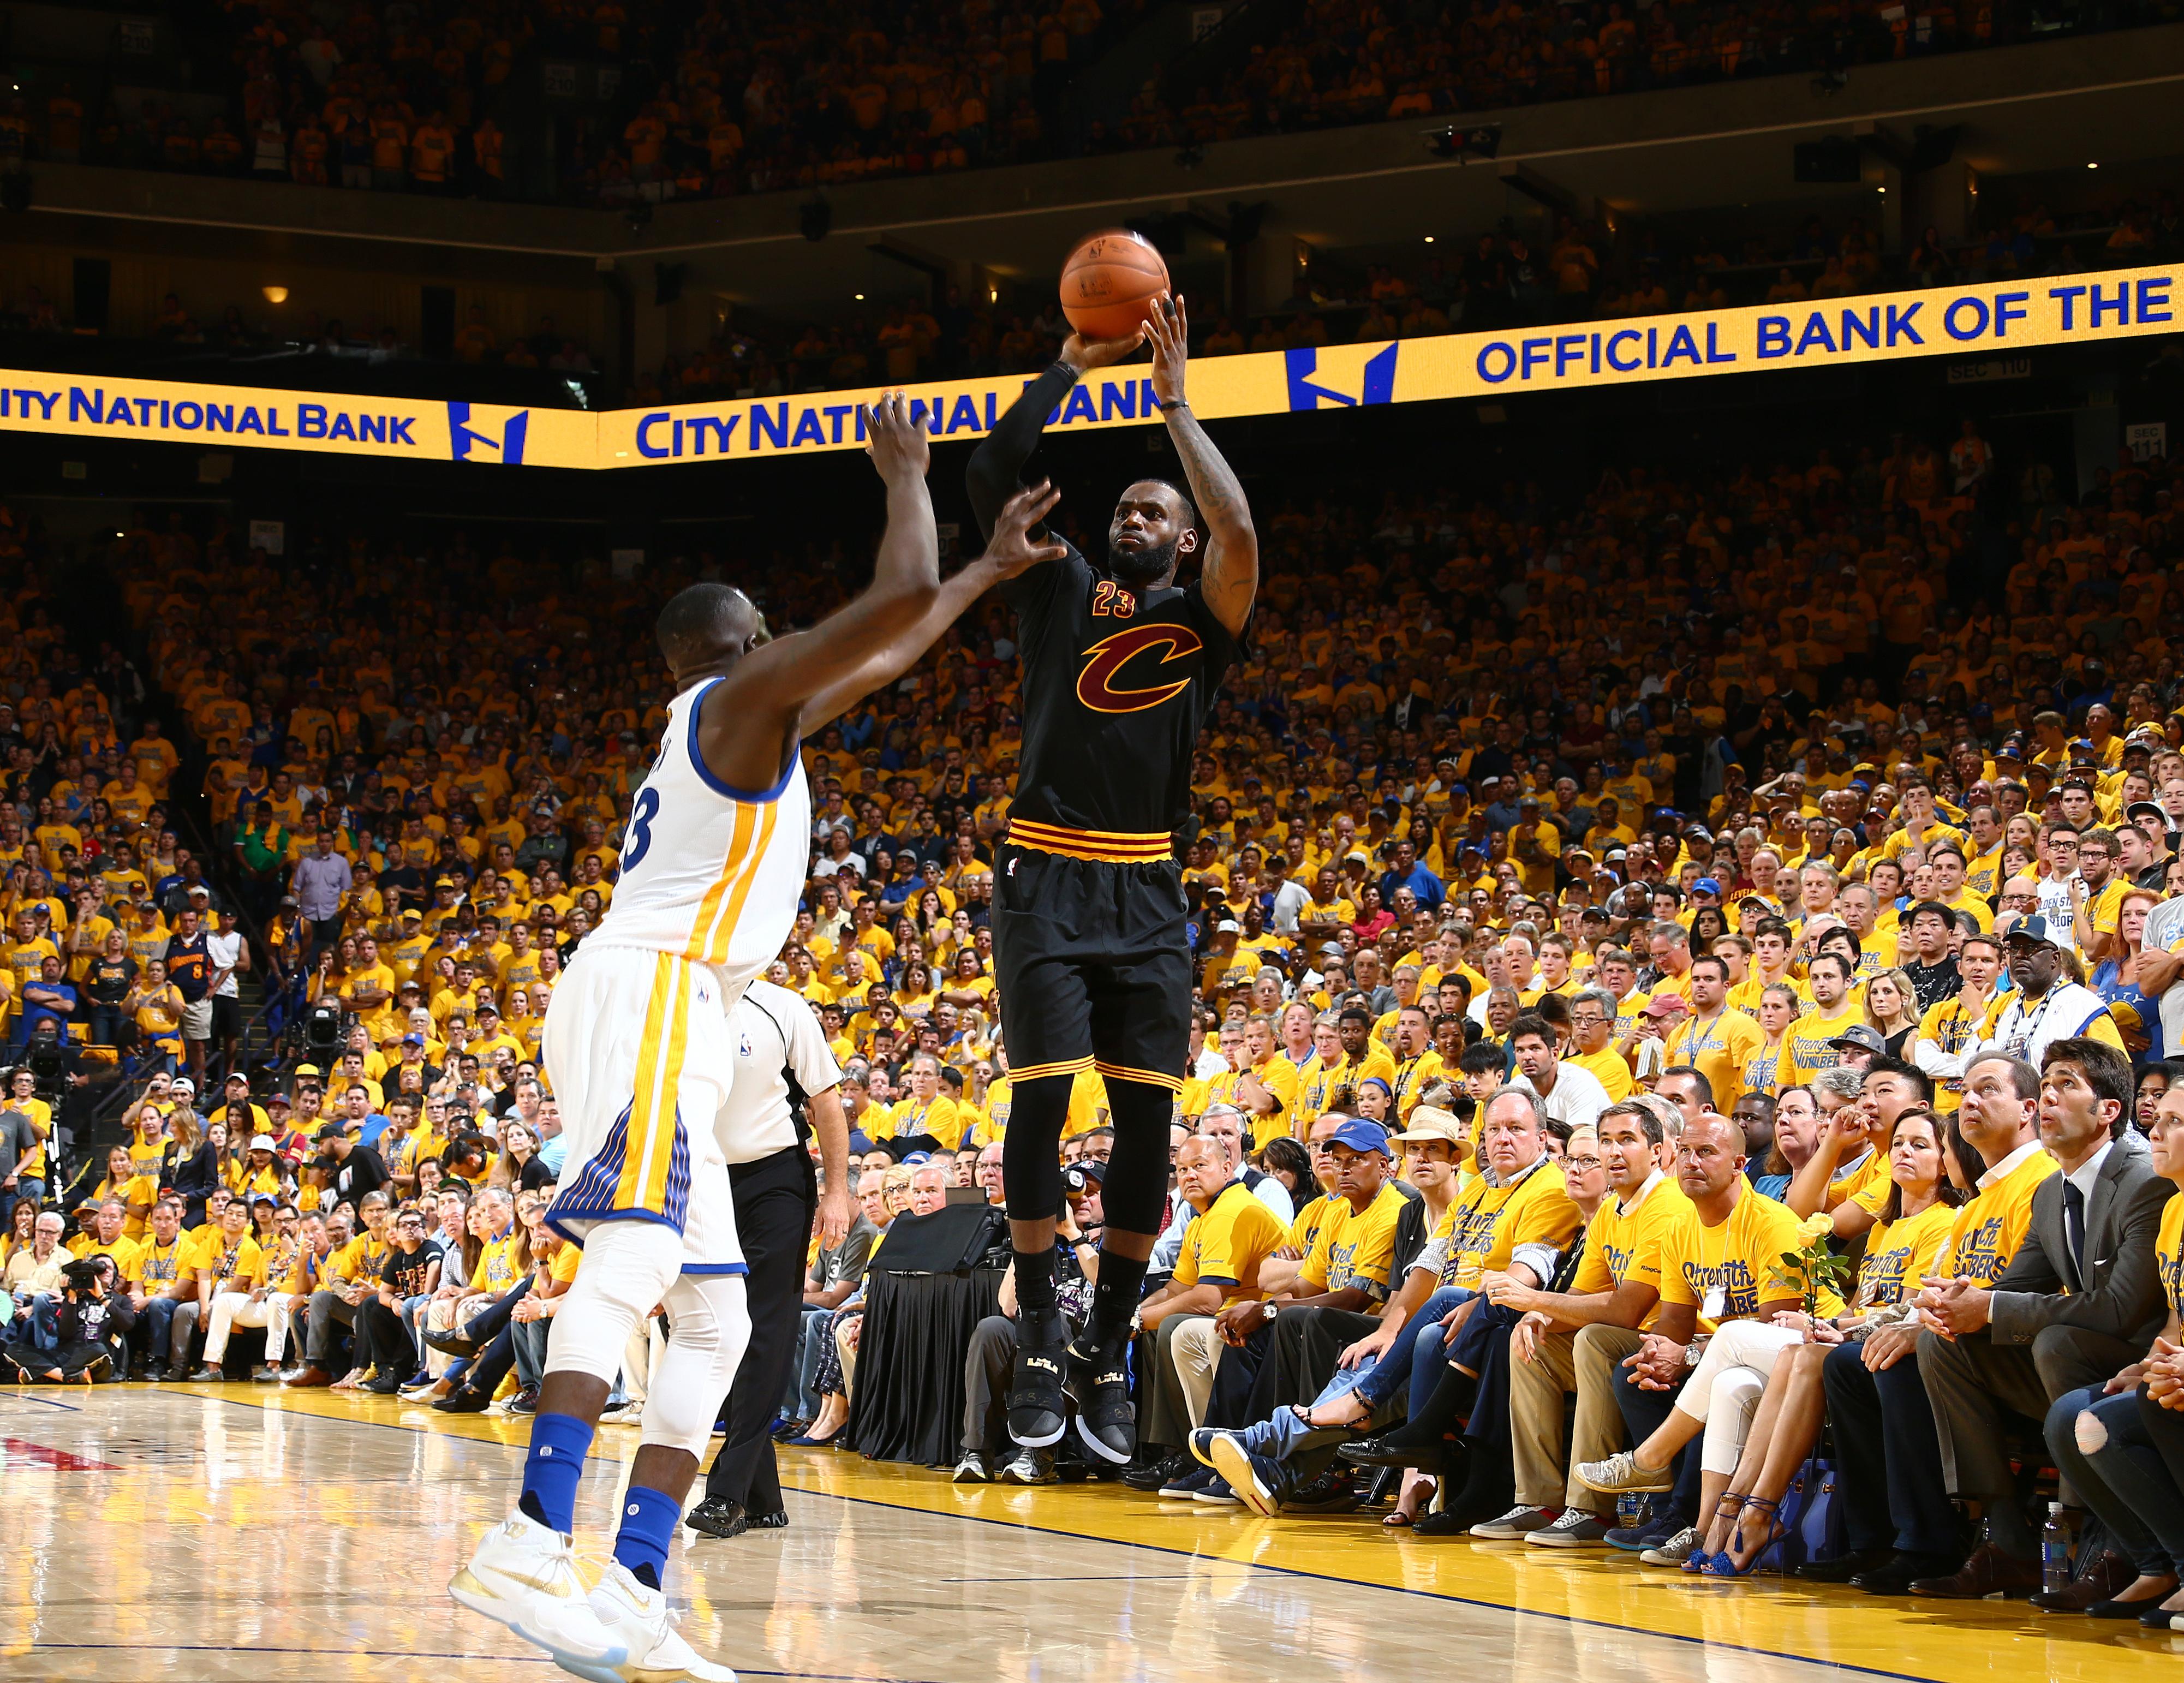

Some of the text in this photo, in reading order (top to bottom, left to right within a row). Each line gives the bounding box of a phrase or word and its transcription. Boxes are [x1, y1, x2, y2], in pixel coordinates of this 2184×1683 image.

[1477, 277, 2172, 383] OFFICIAL BANK OF THE
[1951, 359, 2028, 379] SEC 110
[70, 387, 289, 435] NATIONAL
[299, 404, 416, 444] BANK
[637, 413, 741, 457] CITY
[750, 392, 996, 450] NATINAL
[2134, 427, 2158, 438] SEC
[2132, 439, 2162, 457] 111
[1093, 581, 1136, 619] 23
[1077, 623, 1203, 713] C
[192, 964, 202, 980] 8
[1682, 1260, 1756, 1294] Strength
